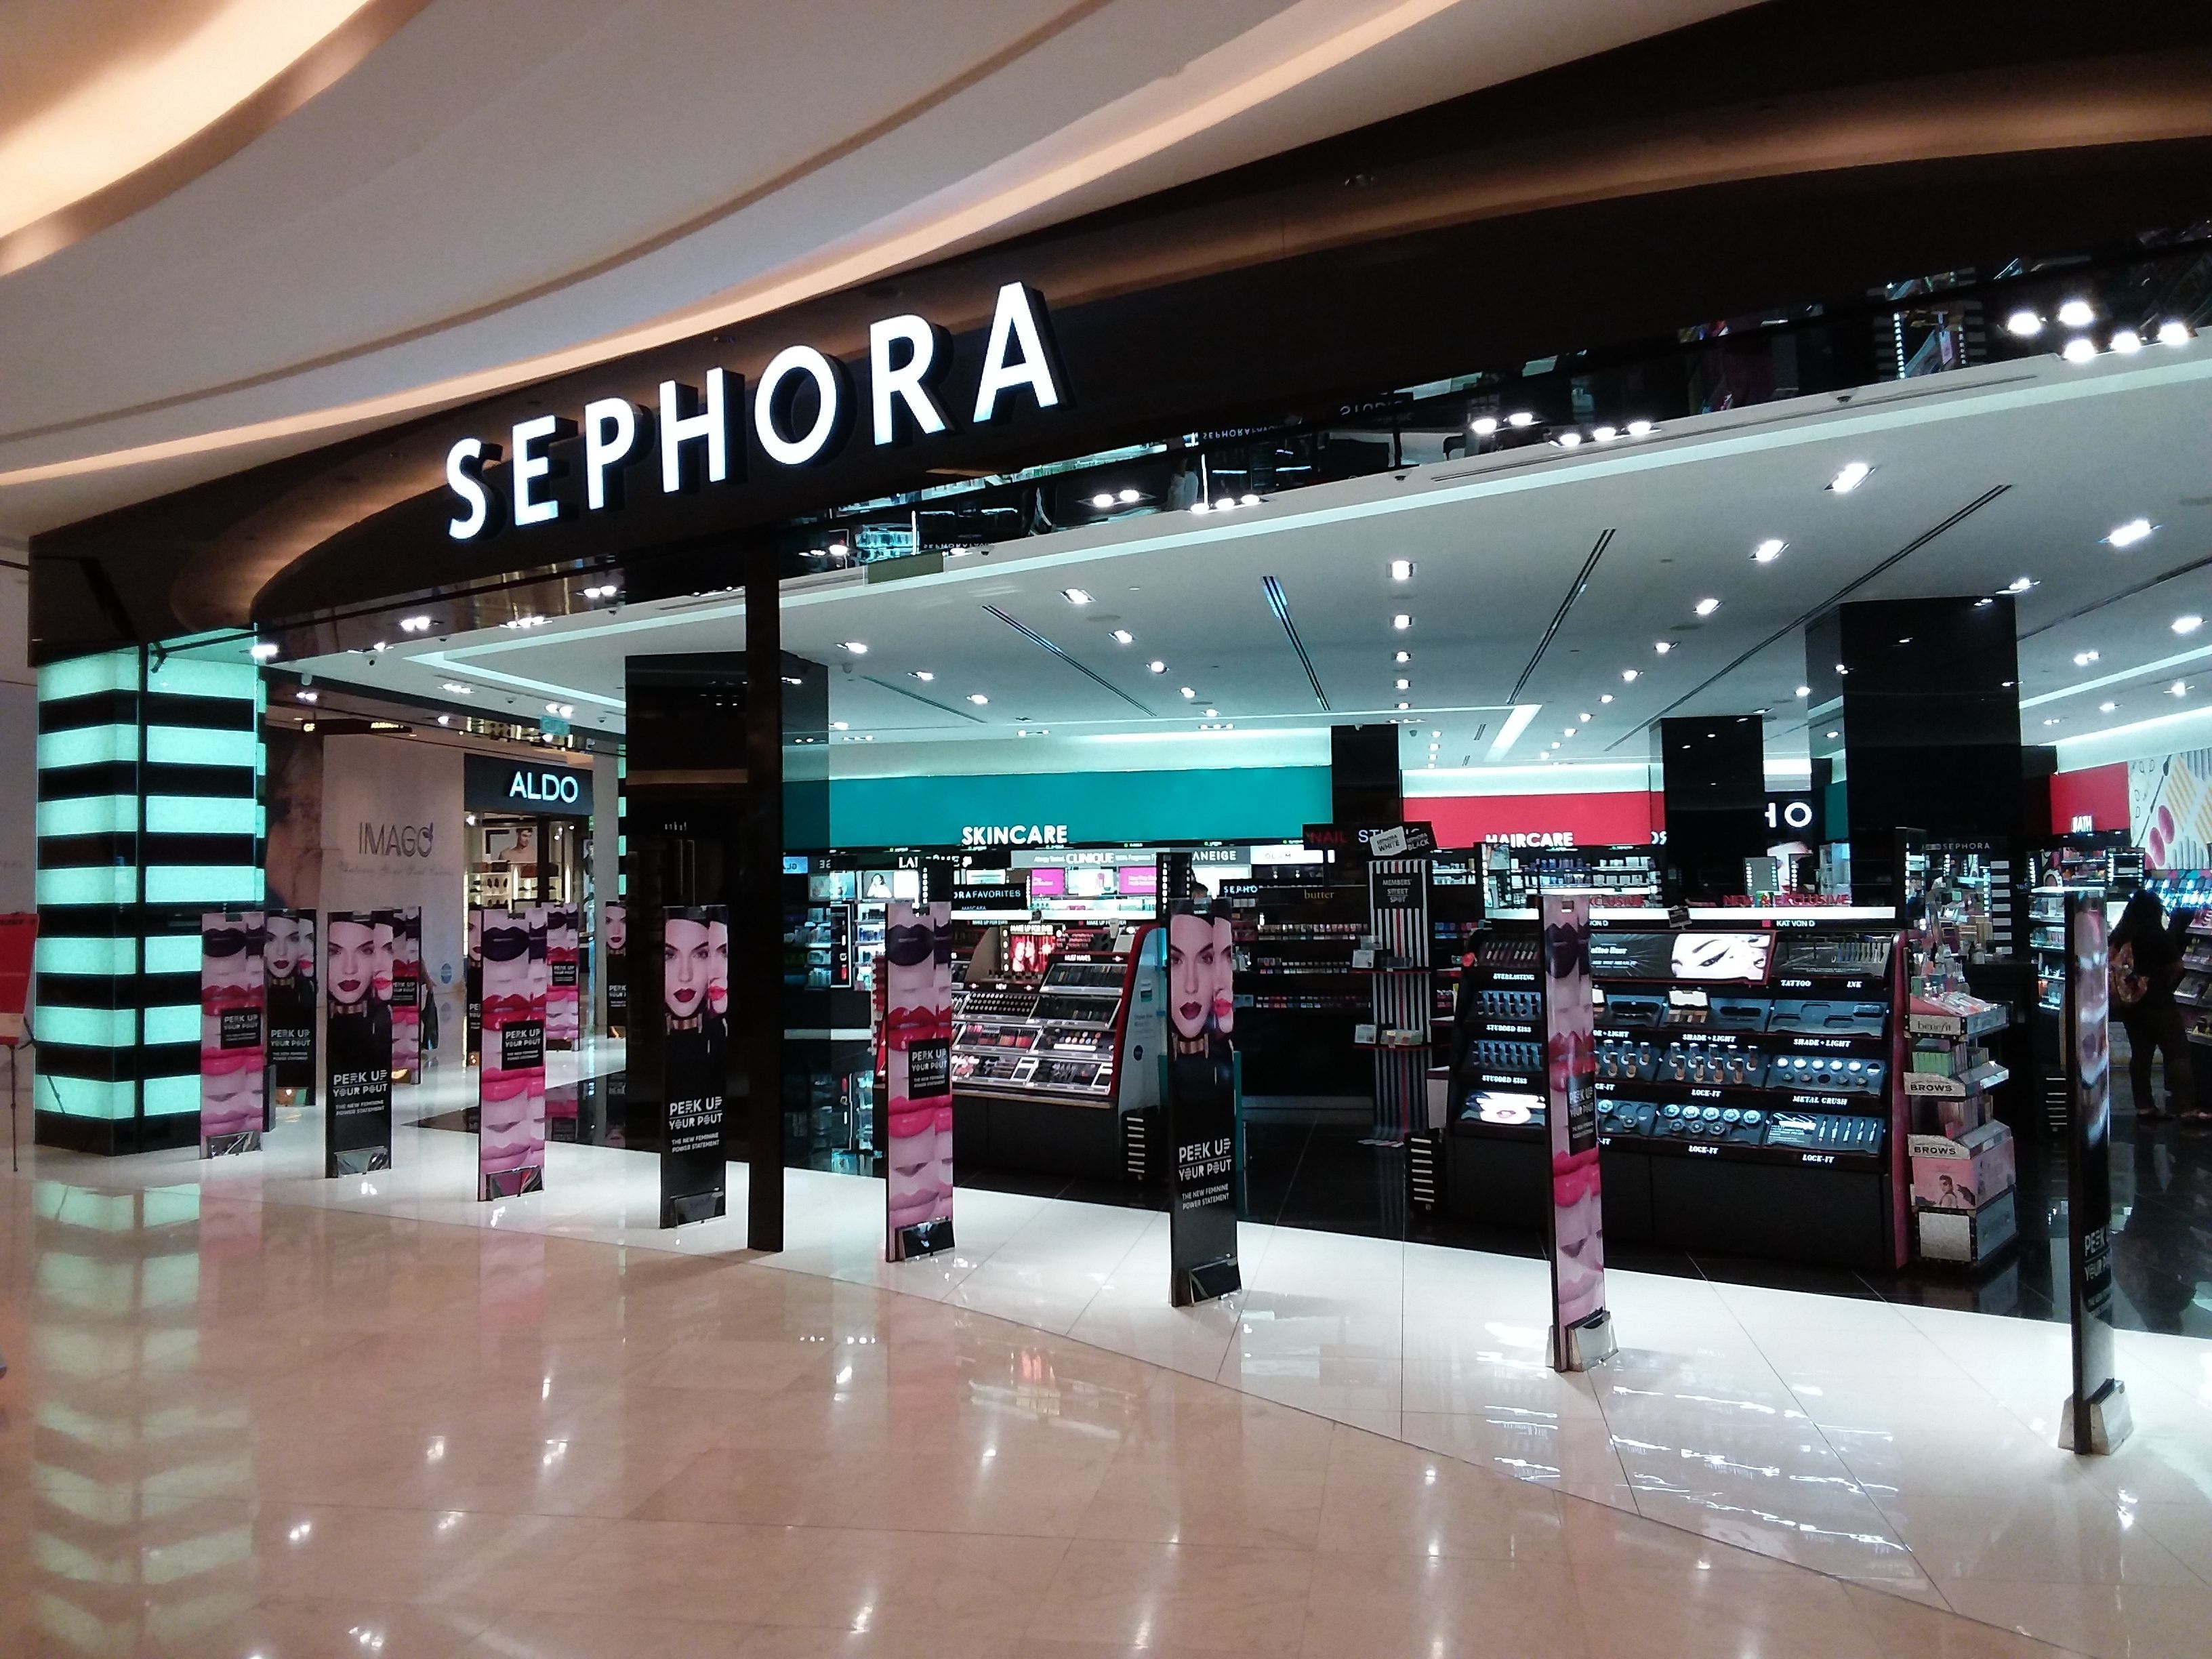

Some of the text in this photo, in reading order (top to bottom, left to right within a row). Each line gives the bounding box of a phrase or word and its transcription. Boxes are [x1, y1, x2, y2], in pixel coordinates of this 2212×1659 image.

[445, 281, 1060, 540] SEPHORA
[510, 771, 579, 804] ALDO
[359, 822, 434, 857] IMAGO
[962, 825, 1067, 846] SKINCARE
[1309, 830, 1348, 844] NAIL
[1485, 832, 1574, 848] HAIRCARE
[1378, 840, 1400, 852] WHITE
[1408, 839, 1430, 851] BLACK
[1065, 853, 1115, 865] CLINIQUE
[1191, 851, 1237, 861] ANEIGE
[972, 890, 1021, 899] FAVORITES
[1304, 889, 1334, 900] butter
[1723, 895, 1755, 906] NEW
[1774, 894, 1850, 906] EXCLUSIVE
[1010, 924, 1024, 933] MAKE
[1024, 924, 1031, 933] UP
[1031, 924, 1042, 933] FOR
[1493, 972, 1535, 981] EVERLASTING
[1780, 979, 1812, 987] TATTOO
[224, 1014, 259, 1023] PERK UP
[1486, 1024, 1532, 1033] STUDDED KISS
[1917, 1020, 1952, 1031] benefit
[270, 1029, 311, 1038] PERK UP
[506, 1028, 541, 1040] PERK UP
[1607, 1030, 1630, 1038] LIGHT
[1682, 1033, 1707, 1042] SHADE
[1712, 1035, 1737, 1043] LIGHT
[505, 1039, 541, 1048] YOUR POUT
[1793, 1038, 1820, 1046] SHADE
[1825, 1039, 1851, 1048] LIGHT
[912, 1048, 947, 1062] PERK UP
[912, 1060, 947, 1072] YOUR POUT
[333, 1069, 388, 1086] PERK UP
[1481, 1075, 1528, 1084] STUDDED KISS
[333, 1083, 388, 1097] YOUR POUT
[1691, 1088, 1722, 1098] LOCK-IT
[1910, 1084, 1952, 1093] BROWS
[669, 1096, 723, 1116] PERK UP
[1792, 1095, 1849, 1106] METAL CRUSH
[668, 1112, 723, 1131] YOUR POUT
[1179, 1138, 1231, 1164] PERK UP
[1688, 1145, 1719, 1155] LOCK-IT
[1913, 1145, 1957, 1155] BROWS
[1801, 1153, 1835, 1164] LOCK-IT
[1178, 1158, 1232, 1182] YOUR POUT
[1181, 1183, 1229, 1201] THE NEW FEMININE
[1182, 1192, 1229, 1210] POWER STATEMENT
